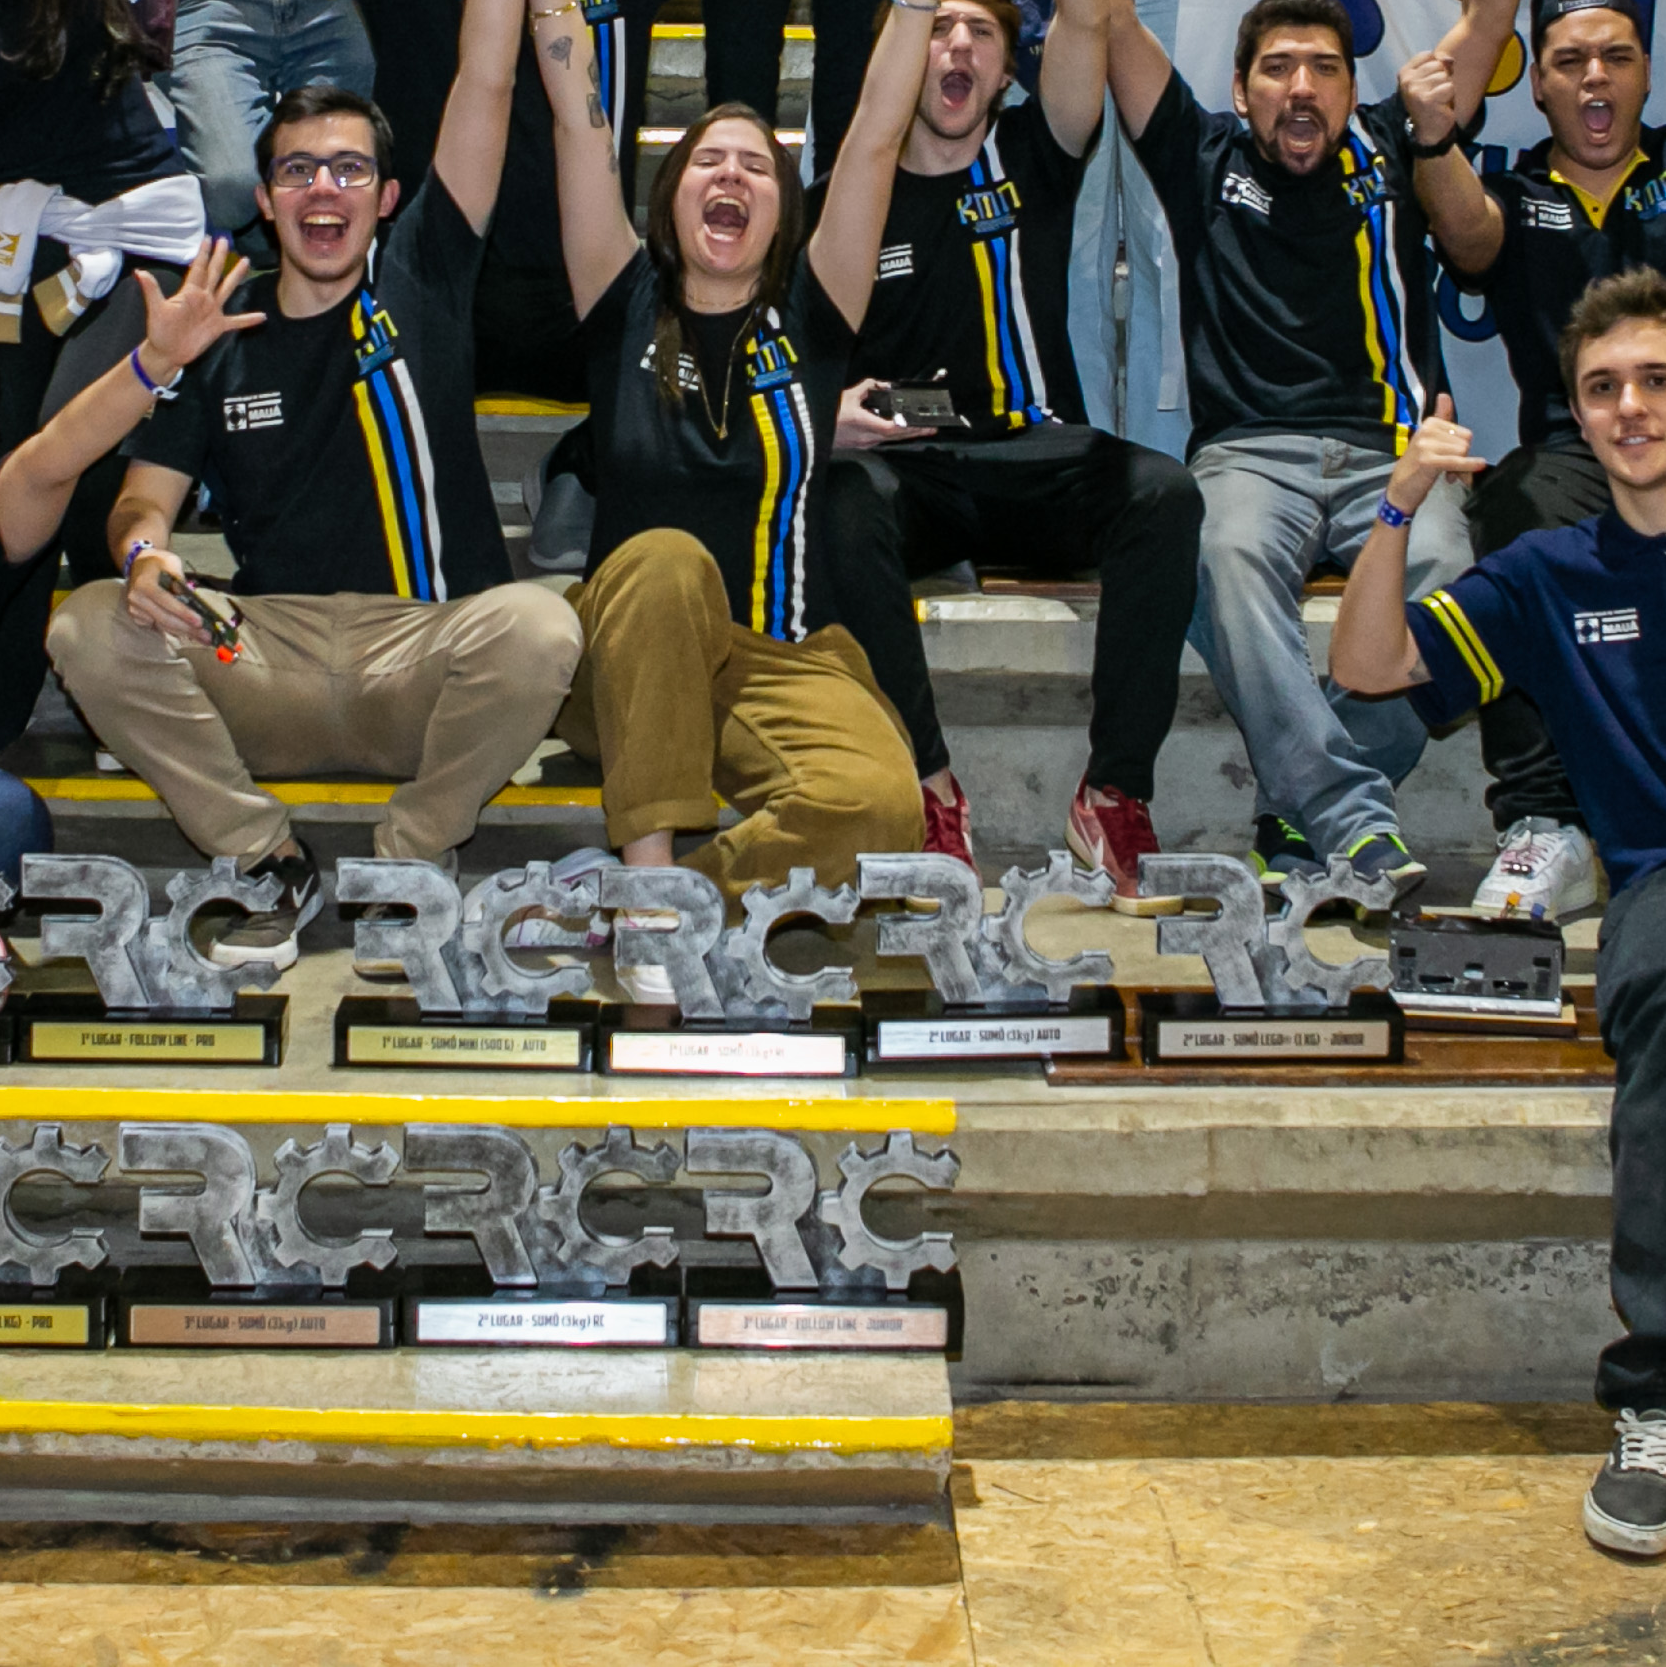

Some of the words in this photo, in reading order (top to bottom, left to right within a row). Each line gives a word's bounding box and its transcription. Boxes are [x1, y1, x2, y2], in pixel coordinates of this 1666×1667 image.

[92, 1034, 122, 1046] LUGAR
[129, 1034, 167, 1046] FOLLOW
[168, 1035, 187, 1047] LINE
[196, 1035, 215, 1047] PRO
[940, 1030, 971, 1043] LUGAR
[1036, 1028, 1061, 1041] AUTO
[1195, 1033, 1226, 1046] LUGAR
[392, 1037, 422, 1049] LUGAR
[522, 1039, 546, 1052] AUTO
[32, 1315, 53, 1329] PRO
[196, 1316, 229, 1330] LUGAR
[299, 1317, 326, 1330] AUTO
[491, 1314, 522, 1327] LUGAR
[593, 1314, 605, 1327] RC
[755, 1317, 787, 1330] LUGAR
